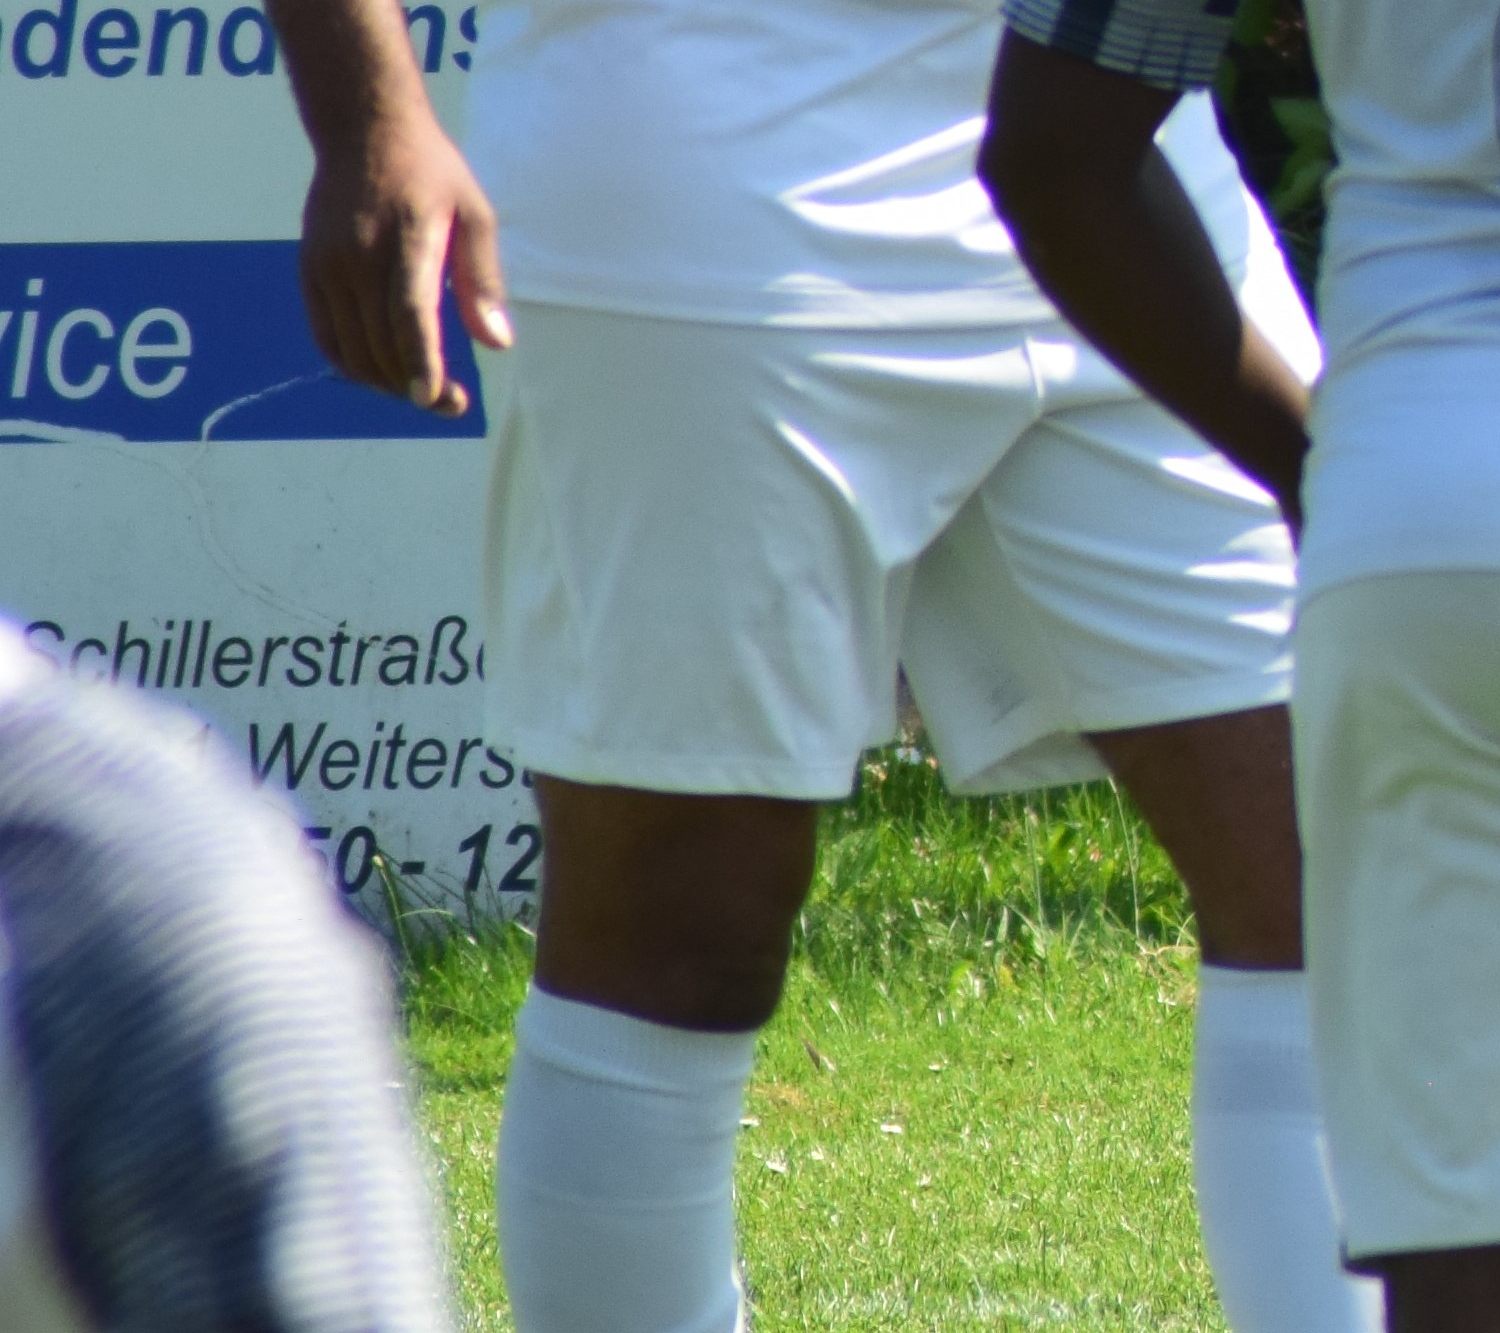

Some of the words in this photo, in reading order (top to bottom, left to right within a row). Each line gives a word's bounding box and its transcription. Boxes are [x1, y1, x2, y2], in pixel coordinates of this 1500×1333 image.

[0, 278, 192, 400] ice
[25, 615, 484, 689] Schillerstraß
[249, 721, 535, 791] Weiters
